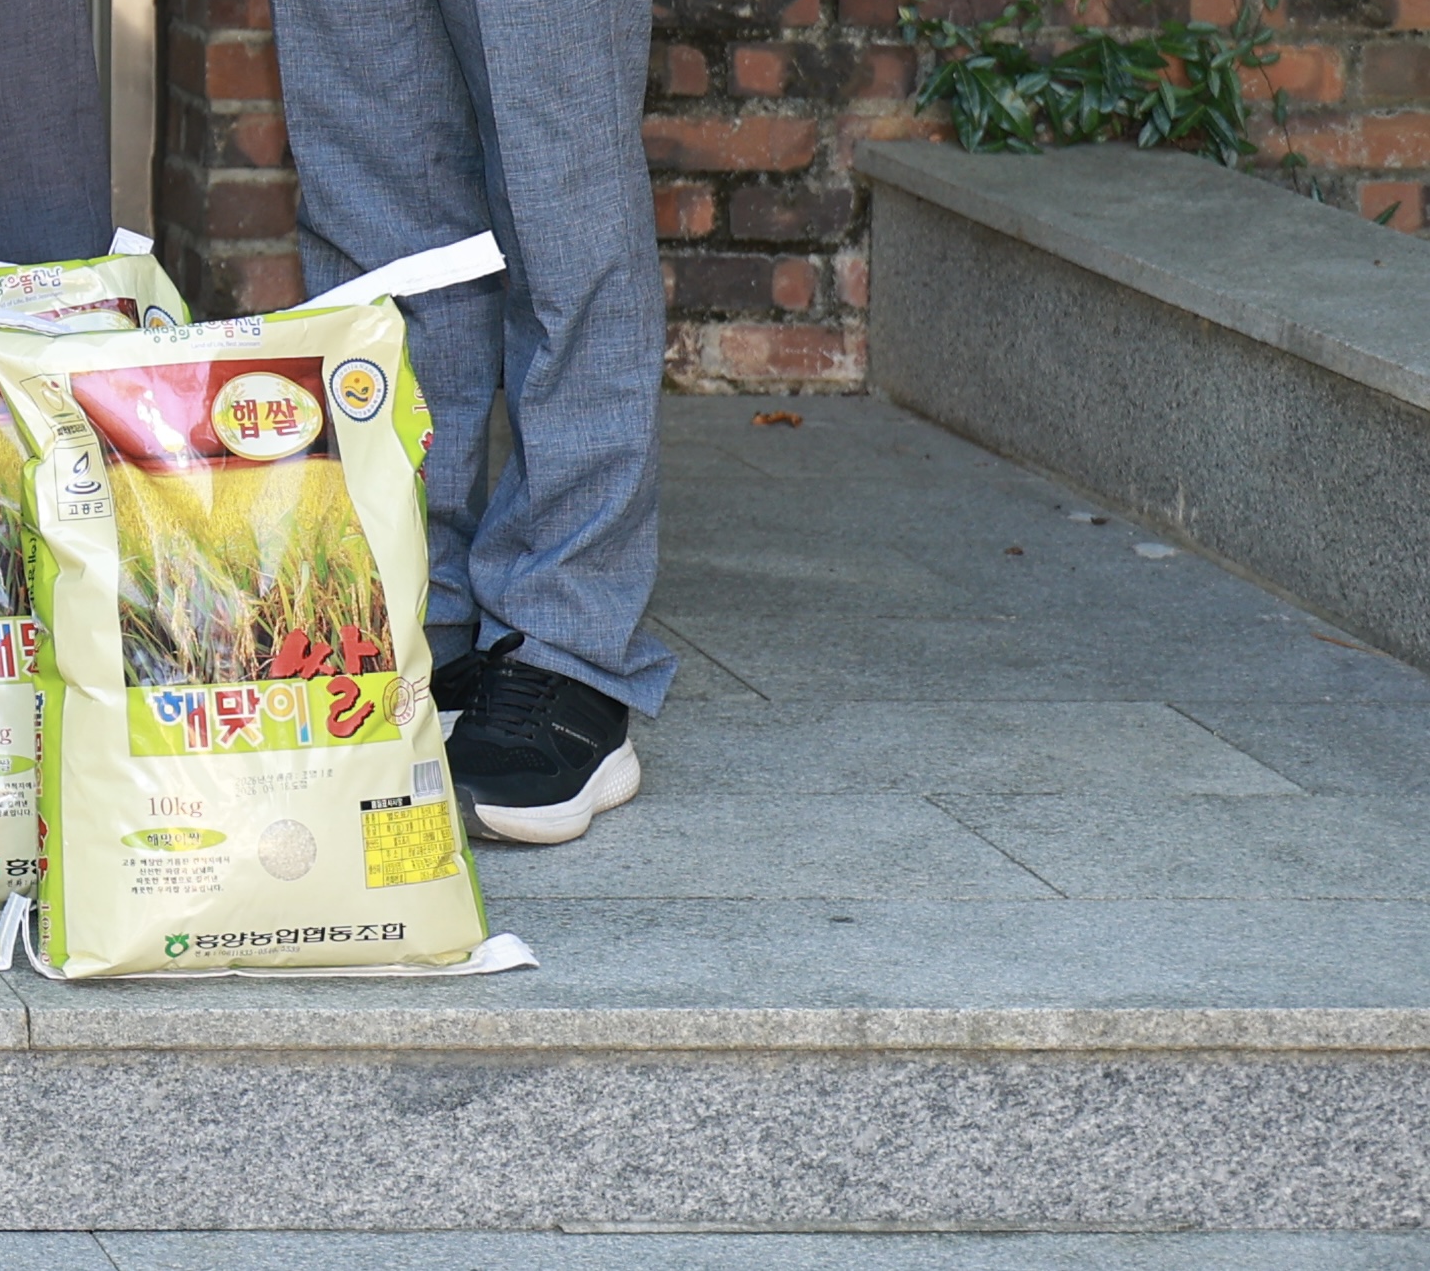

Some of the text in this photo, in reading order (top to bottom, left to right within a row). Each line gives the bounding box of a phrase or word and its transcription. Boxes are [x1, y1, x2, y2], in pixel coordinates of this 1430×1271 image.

[231, 397, 299, 440] 햅쌀
[68, 501, 105, 516] 고흥군
[153, 682, 310, 749] 해맞이
[272, 626, 391, 739] 쌀
[147, 796, 203, 818] 10kg
[146, 832, 201, 846] 해맞이쌀
[195, 922, 407, 949] 흥양농업협동조합
